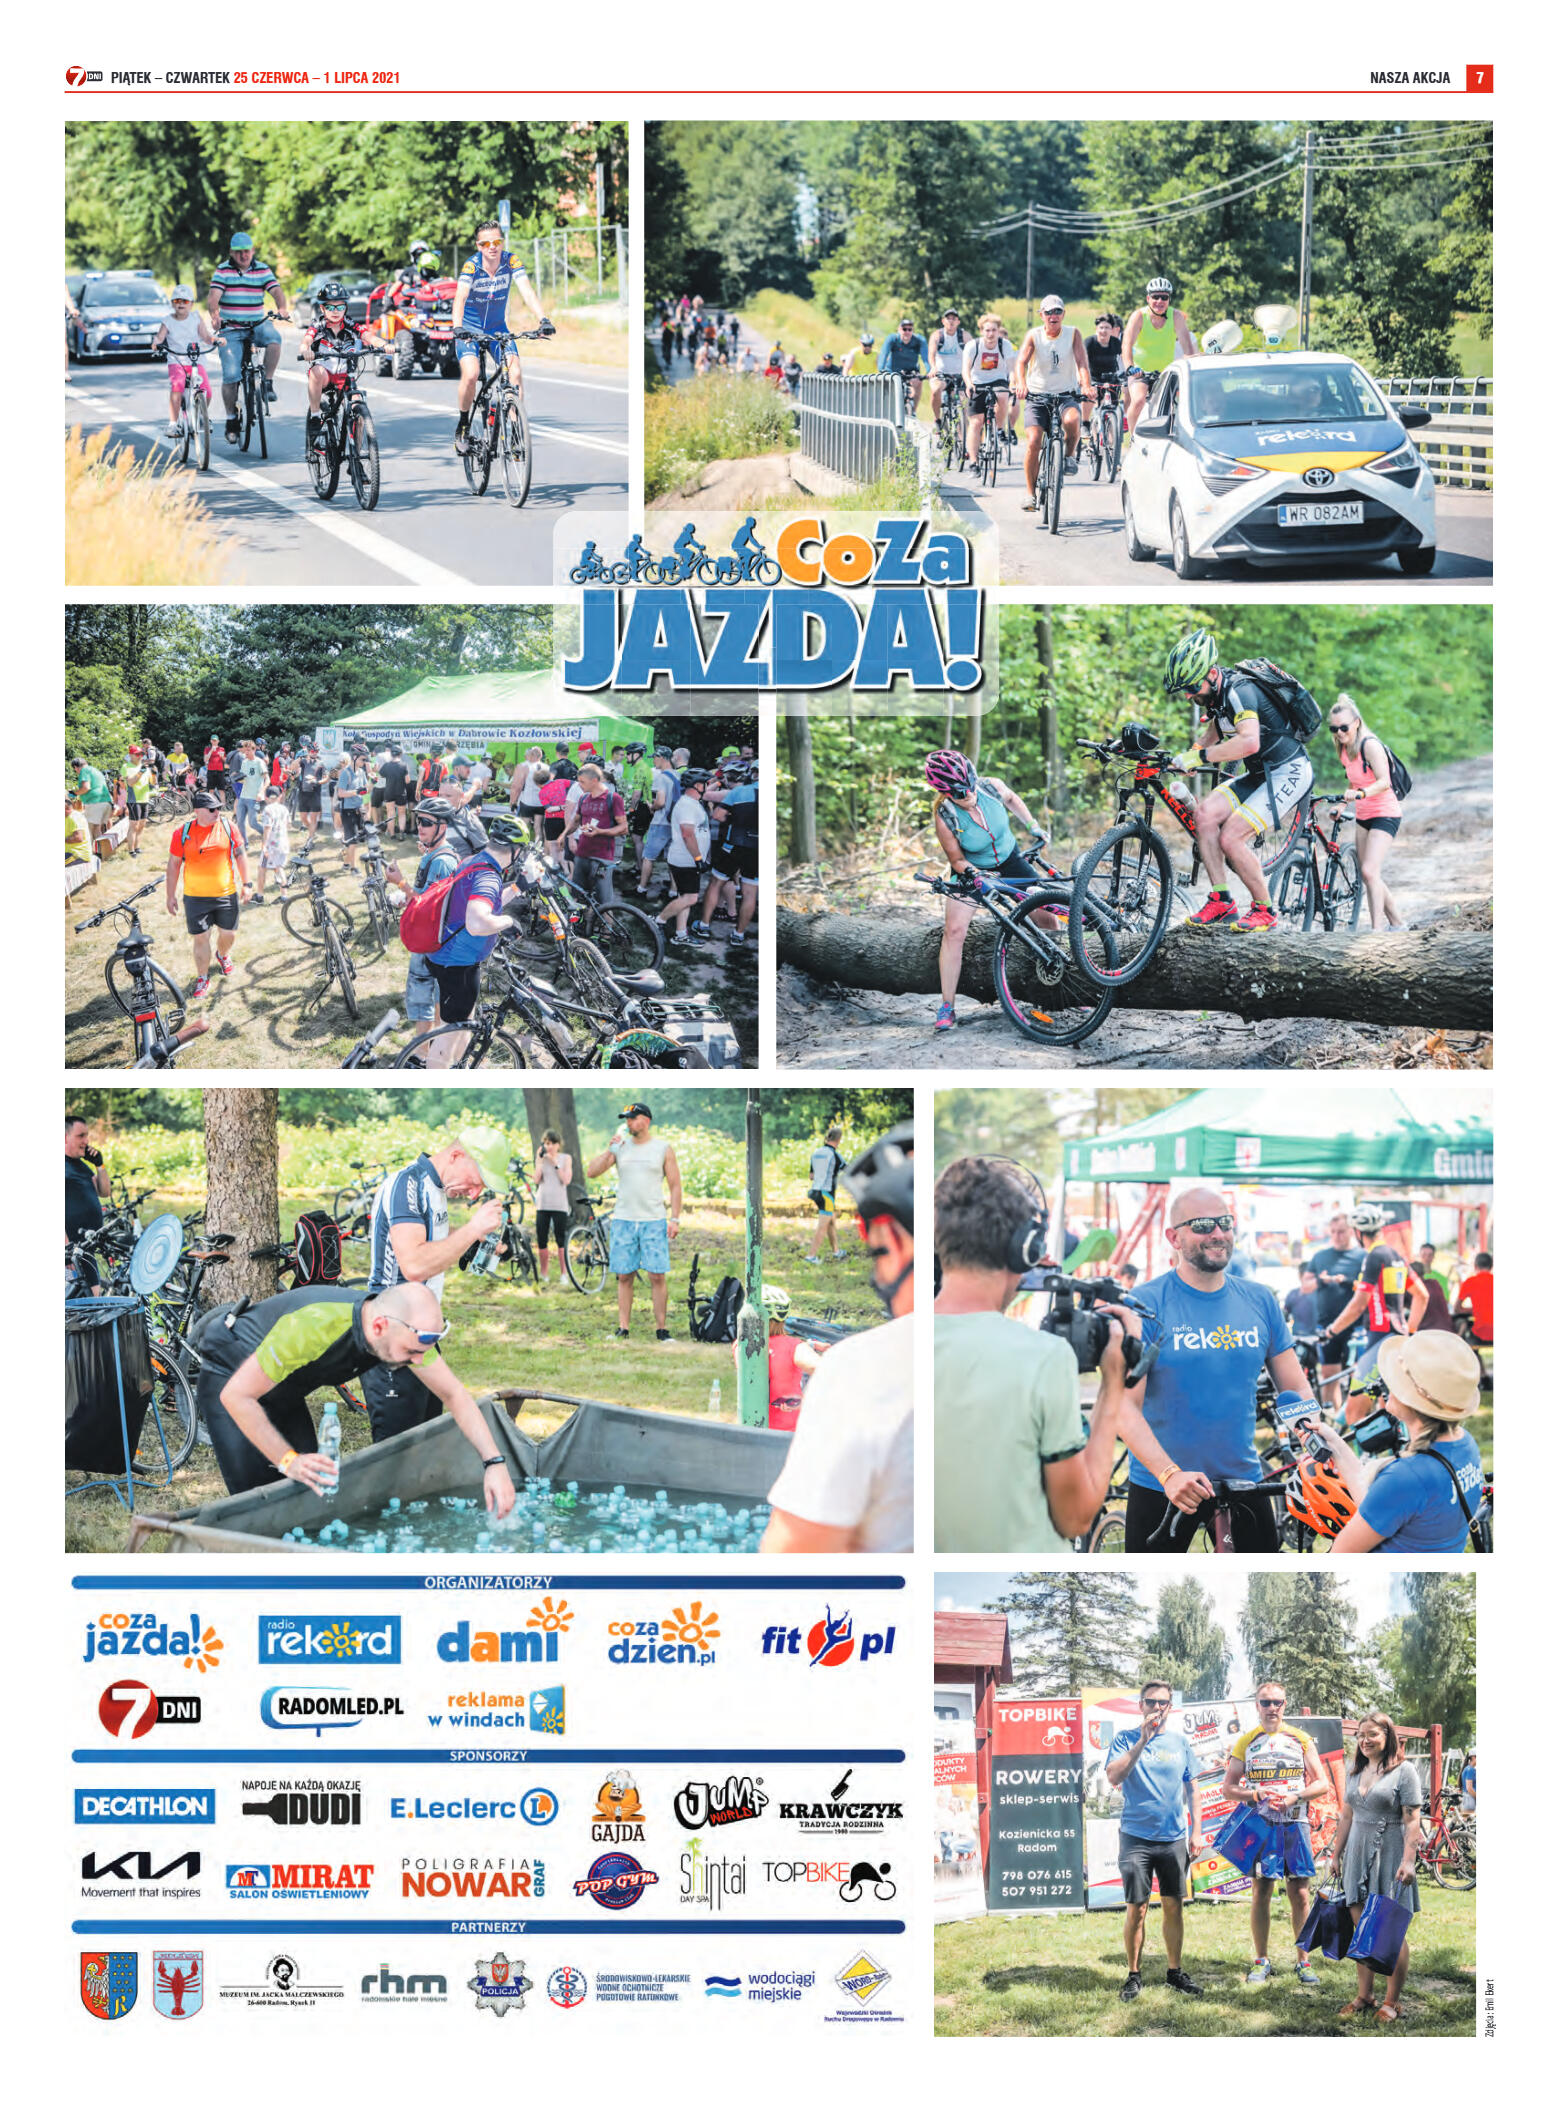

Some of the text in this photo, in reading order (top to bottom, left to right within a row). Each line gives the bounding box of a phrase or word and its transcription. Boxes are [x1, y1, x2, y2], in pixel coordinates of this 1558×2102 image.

[67, 67, 101, 86] 7 DNI
[111, 71, 151, 86] PIĄTEK
[166, 71, 231, 84] CZWARTEK
[233, 71, 248, 84] 25
[251, 71, 310, 84] CZERWCA
[324, 71, 330, 84] 1
[334, 71, 369, 84] LIPCA
[372, 71, 400, 84] 2021
[1370, 72, 1451, 84] NASZA AKCJA
[1475, 71, 1485, 85] 7
[1289, 504, 1360, 521] WR 082AM
[403, 729, 446, 740] Wiejskich
[509, 726, 583, 740] Kozłowskiej
[413, 740, 433, 749] GMIN
[1275, 761, 1303, 804] TEAM
[1172, 1324, 1193, 1334] radio
[424, 1576, 553, 1589] ORGANIZATORZY
[99, 1613, 156, 1630] coza
[267, 1618, 295, 1630] radio
[608, 1621, 659, 1637] coza
[83, 1614, 202, 1663] jazda!
[436, 1620, 559, 1663] dami
[761, 1626, 802, 1655] fit
[608, 1637, 716, 1667] dzien.pl
[278, 1697, 404, 1715] RADOMLED.PL
[447, 1691, 525, 1708] reklama
[111, 1687, 198, 1739] 7 DNI
[427, 1711, 525, 1728] w windach
[998, 1707, 1077, 1723] TOPBIKE
[449, 1750, 528, 1762] SPONSORZY
[242, 1778, 361, 1792] NAPOJE NA KAŻDĄ OKAZJĘ
[995, 1768, 1082, 1786] ROWERY
[82, 1796, 208, 1817] DECATHLON
[674, 1775, 770, 1830] JUMP
[999, 1792, 1080, 1806] sklep-serwis
[289, 1793, 361, 1825] DUDI
[390, 1797, 516, 1819] E.Leclerc
[709, 1806, 753, 1825] WORLD
[779, 1802, 904, 1819] KRAWCZYK
[591, 1823, 646, 1844] GAJDA
[999, 1829, 1061, 1840] Kozienicka
[1017, 1842, 1058, 1853] Radom
[401, 1858, 531, 1871] POLIGRAFIA
[762, 1862, 849, 1883] TOPBIKE
[271, 1864, 374, 1889] MIRAT
[533, 1858, 546, 1898] GRAF
[575, 1870, 659, 1896] POP GYM
[680, 1838, 747, 1911] Shintai
[1002, 1869, 1072, 1881] 798 076 615
[82, 1887, 201, 1900] Movement that inspires
[402, 1872, 532, 1898] NOWAR
[1002, 1885, 1072, 1897] 507 951 272
[229, 1888, 370, 1900] SALON OŚWIETLENIOWY
[680, 1895, 710, 1903] DAY SPA
[451, 1921, 527, 1933] PARTNERZY
[361, 1963, 447, 1994] rhm
[748, 1970, 816, 1988] wodociągi
[481, 1986, 519, 1996] POLICJA
[596, 1983, 665, 1992] WODNE OCHOTNICZE
[748, 1987, 802, 2003] miejskie
[596, 1993, 679, 2001] POGOTOWIE RATUNKOWE
